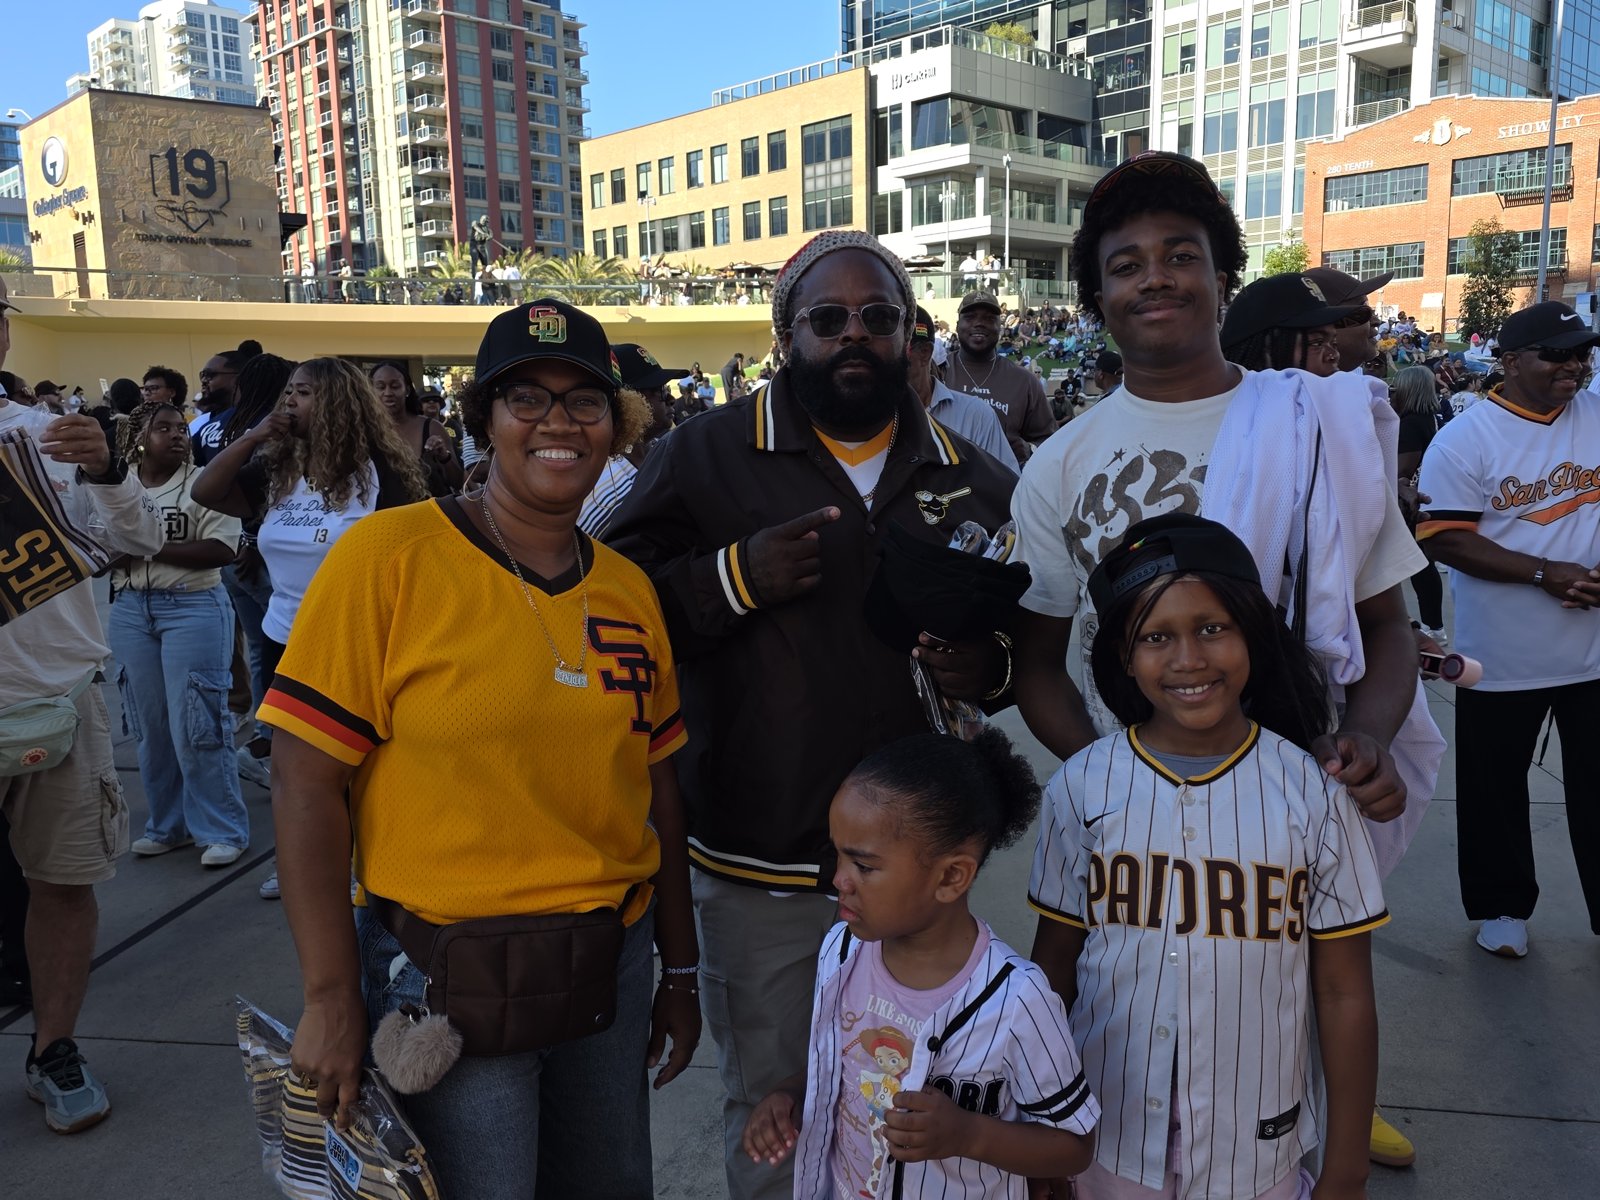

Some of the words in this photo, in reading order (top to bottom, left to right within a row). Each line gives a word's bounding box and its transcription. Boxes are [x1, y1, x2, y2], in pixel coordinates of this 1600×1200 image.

[1498, 115, 1584, 139] SHOWEY
[165, 147, 217, 199] 19
[1345, 160, 1374, 172] TENTH
[528, 305, 567, 344] SD
[273, 499, 302, 511] San
[1492, 476, 1548, 511] San
[272, 511, 324, 527] Padres
[313, 529, 329, 543] 13
[1086, 851, 1309, 944] PADRES
[867, 994, 897, 1020] LIKE
[928, 1074, 1006, 1118] ORK
